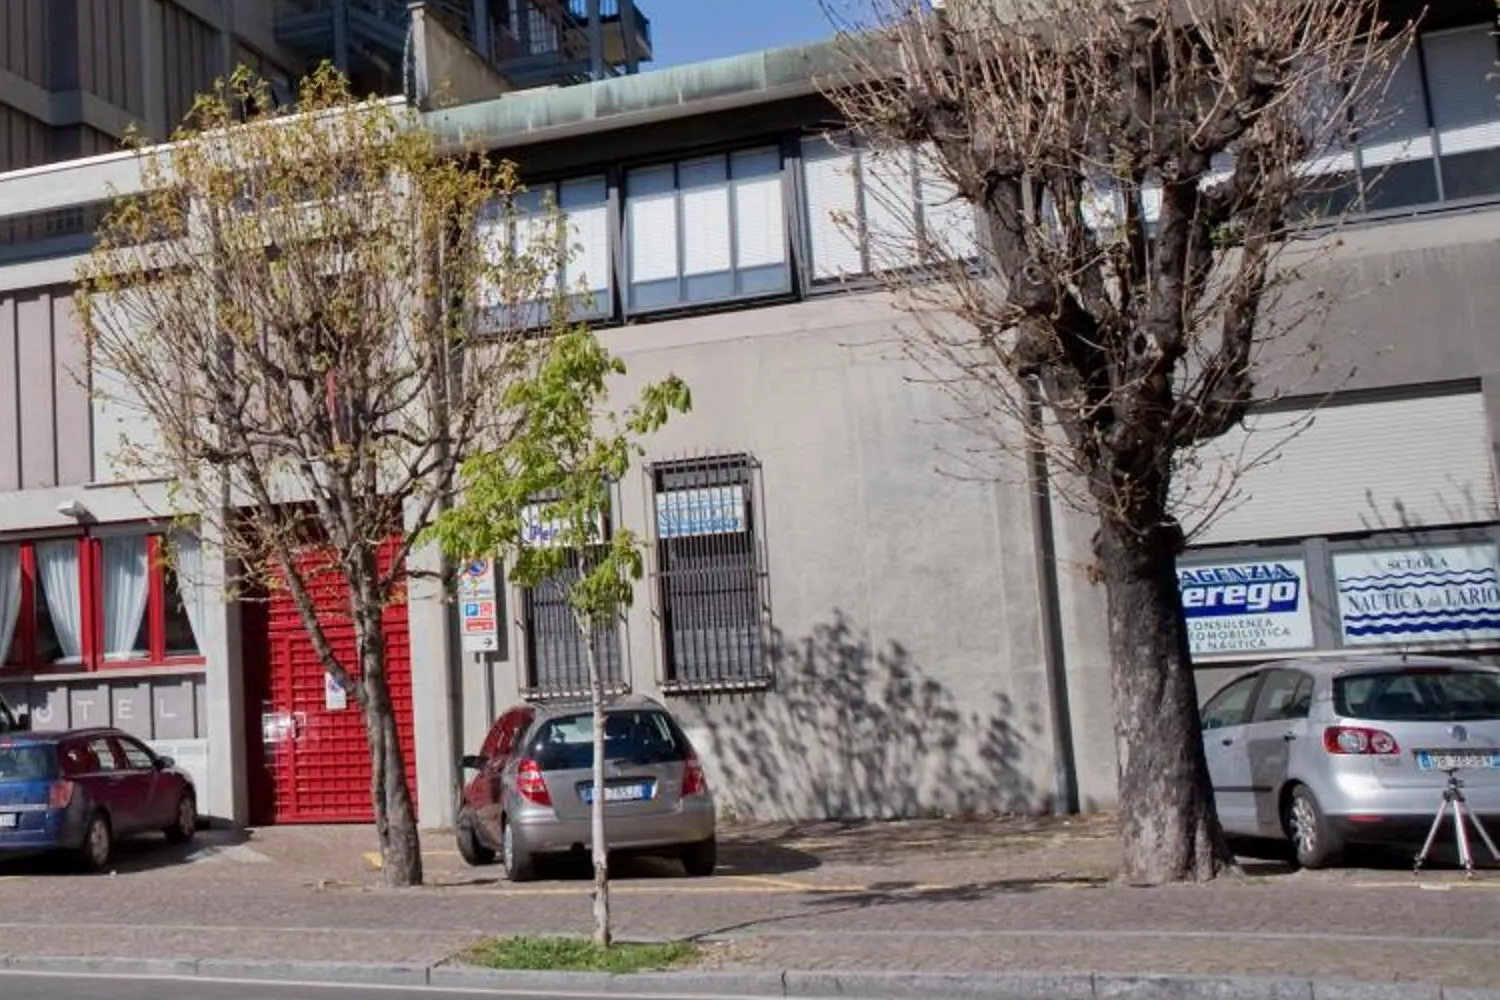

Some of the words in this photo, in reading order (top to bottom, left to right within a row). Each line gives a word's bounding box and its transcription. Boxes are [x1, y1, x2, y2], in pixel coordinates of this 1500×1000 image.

[1180, 563, 1295, 585] AGENZIA
[1387, 557, 1448, 570] SCUOLA
[1181, 580, 1297, 611] erego
[1348, 589, 1424, 612] NAUTICA
[1207, 638, 1267, 650] NAUTICA
[35, 699, 177, 722] OTEL
